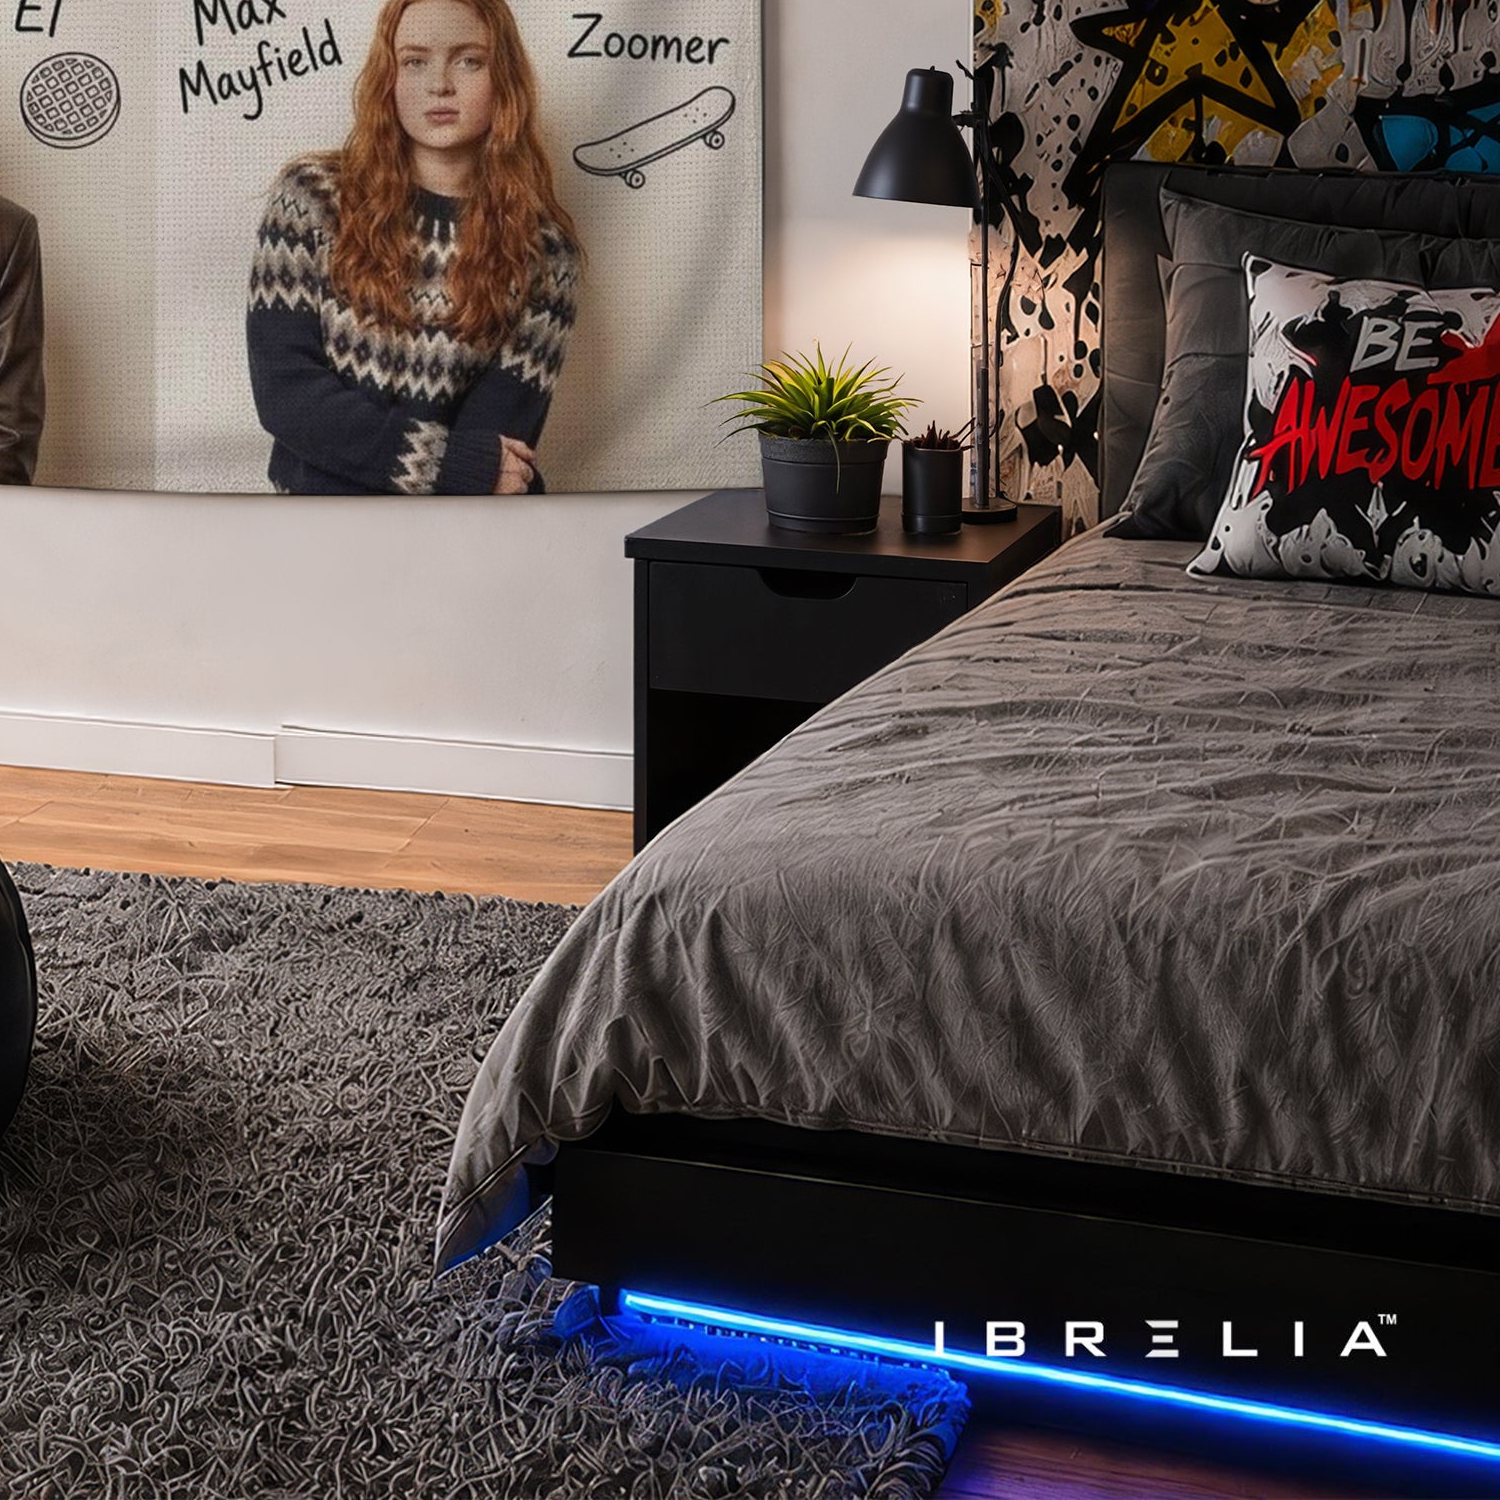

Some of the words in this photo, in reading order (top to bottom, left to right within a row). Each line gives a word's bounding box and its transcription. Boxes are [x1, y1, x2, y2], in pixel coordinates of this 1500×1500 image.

[566, 13, 730, 65] Zoomer
[178, 18, 343, 121] Mayfield
[1350, 315, 1444, 373] BE
